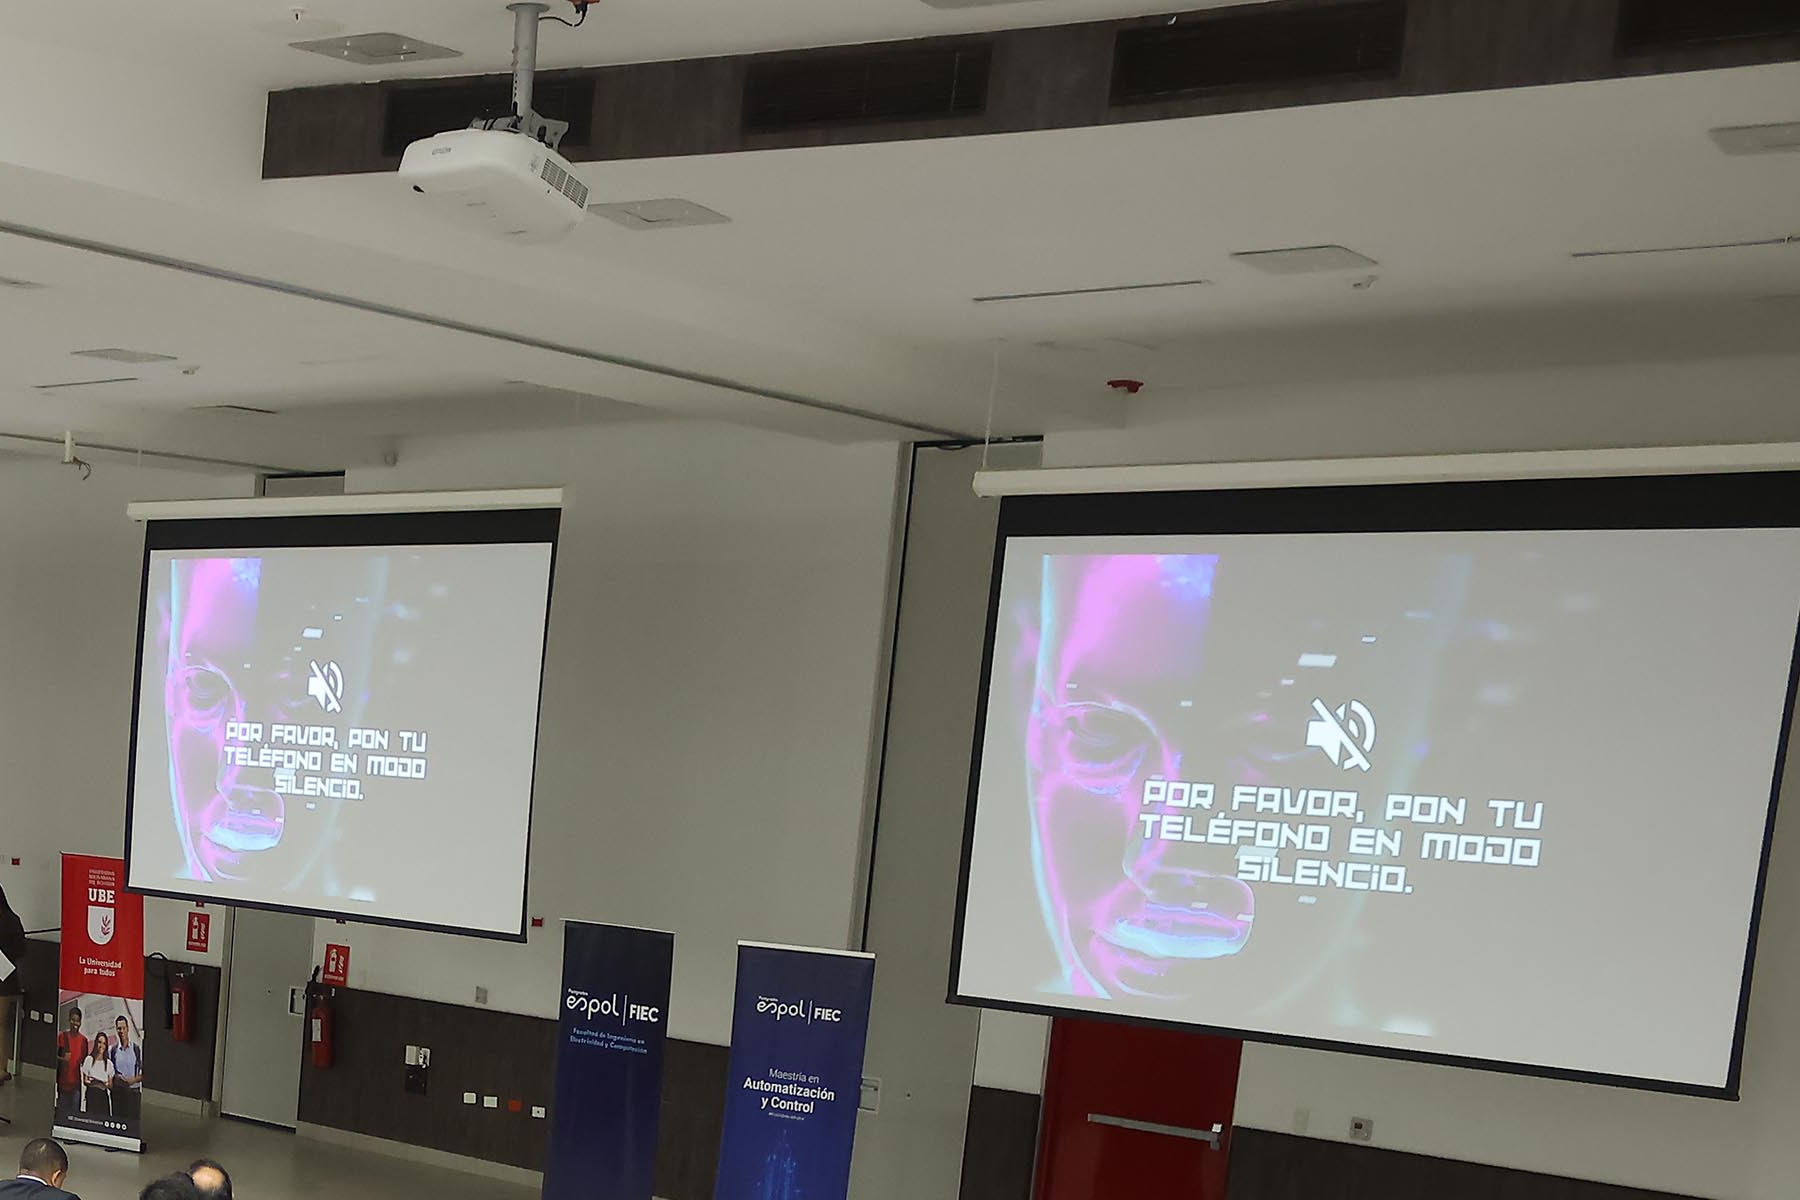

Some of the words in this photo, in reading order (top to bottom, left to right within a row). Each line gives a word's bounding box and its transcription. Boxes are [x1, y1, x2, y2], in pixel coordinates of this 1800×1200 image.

[225, 722, 263, 742] POR
[271, 724, 338, 750] FAVOR,
[348, 728, 389, 750] PON
[400, 731, 426, 752] TU
[224, 743, 321, 770] TELÉFONO
[330, 753, 358, 773] EN
[367, 755, 426, 778] MODO
[274, 774, 364, 800] SILENCIO.
[1143, 779, 1215, 809] POR
[1232, 785, 1365, 823] FAVOR,
[1385, 794, 1467, 824] PON
[1488, 800, 1544, 830] TU
[1140, 813, 1330, 852] TELÉFONO
[1349, 828, 1402, 856] EN
[1421, 832, 1541, 866] MODO
[1237, 855, 1413, 894] SILENCIO.
[88, 888, 115, 903] UBE
[87, 958, 121, 968] Universidad
[99, 968, 115, 976] todos
[567, 994, 619, 1020] espol
[629, 1004, 659, 1022] FIEC
[757, 1000, 805, 1020] espol
[814, 1008, 841, 1021] FIEC
[769, 1068, 806, 1082] Maestría
[808, 1075, 819, 1084] en
[744, 1077, 834, 1101] Automatización
[761, 1097, 768, 1109] y
[771, 1096, 814, 1113] Control
